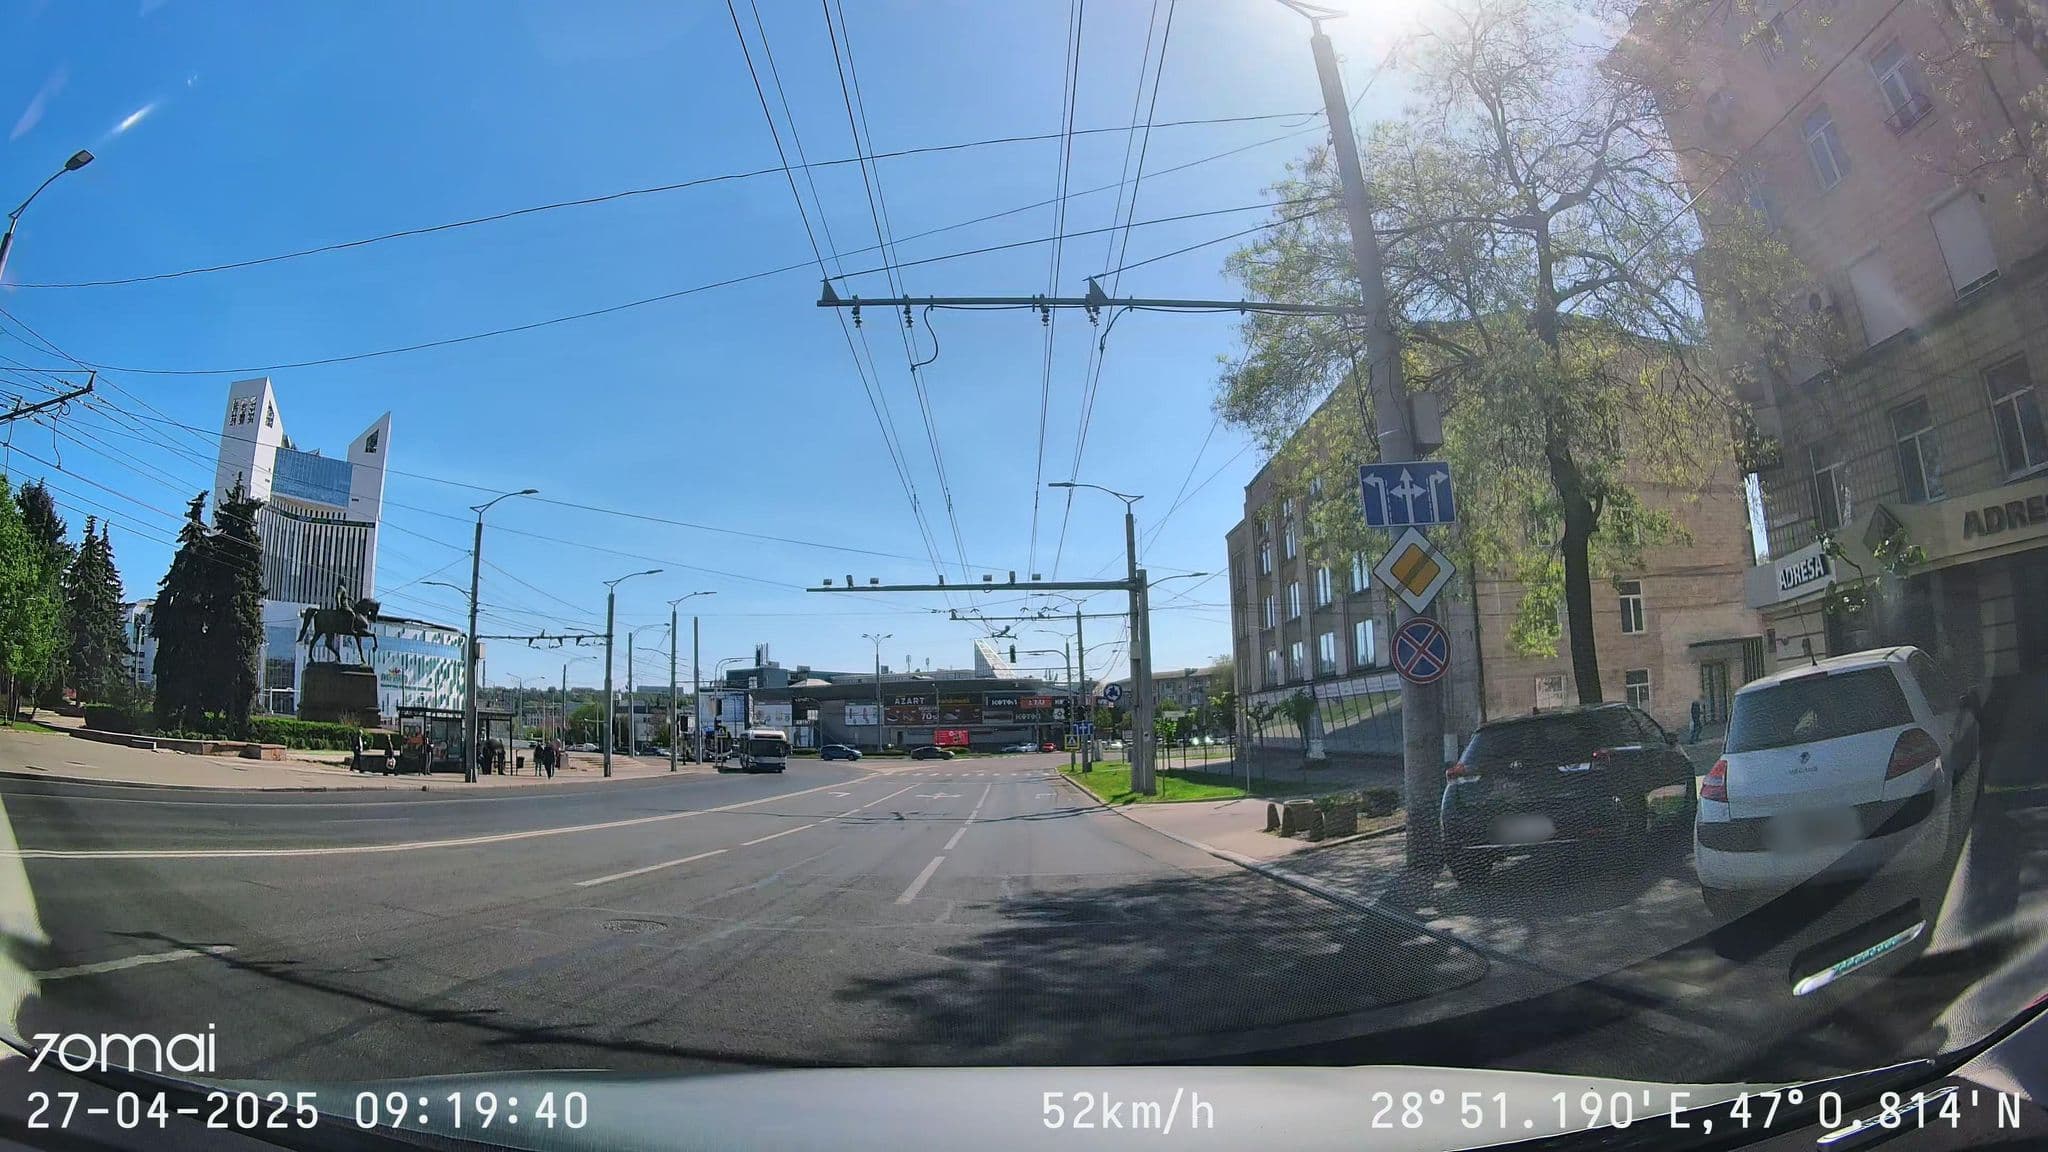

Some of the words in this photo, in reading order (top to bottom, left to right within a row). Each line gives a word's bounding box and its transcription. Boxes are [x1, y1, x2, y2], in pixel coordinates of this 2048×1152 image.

[1963, 495, 2048, 539] ADRE
[1778, 552, 1825, 591] ADRESA
[894, 697, 925, 705] AZART
